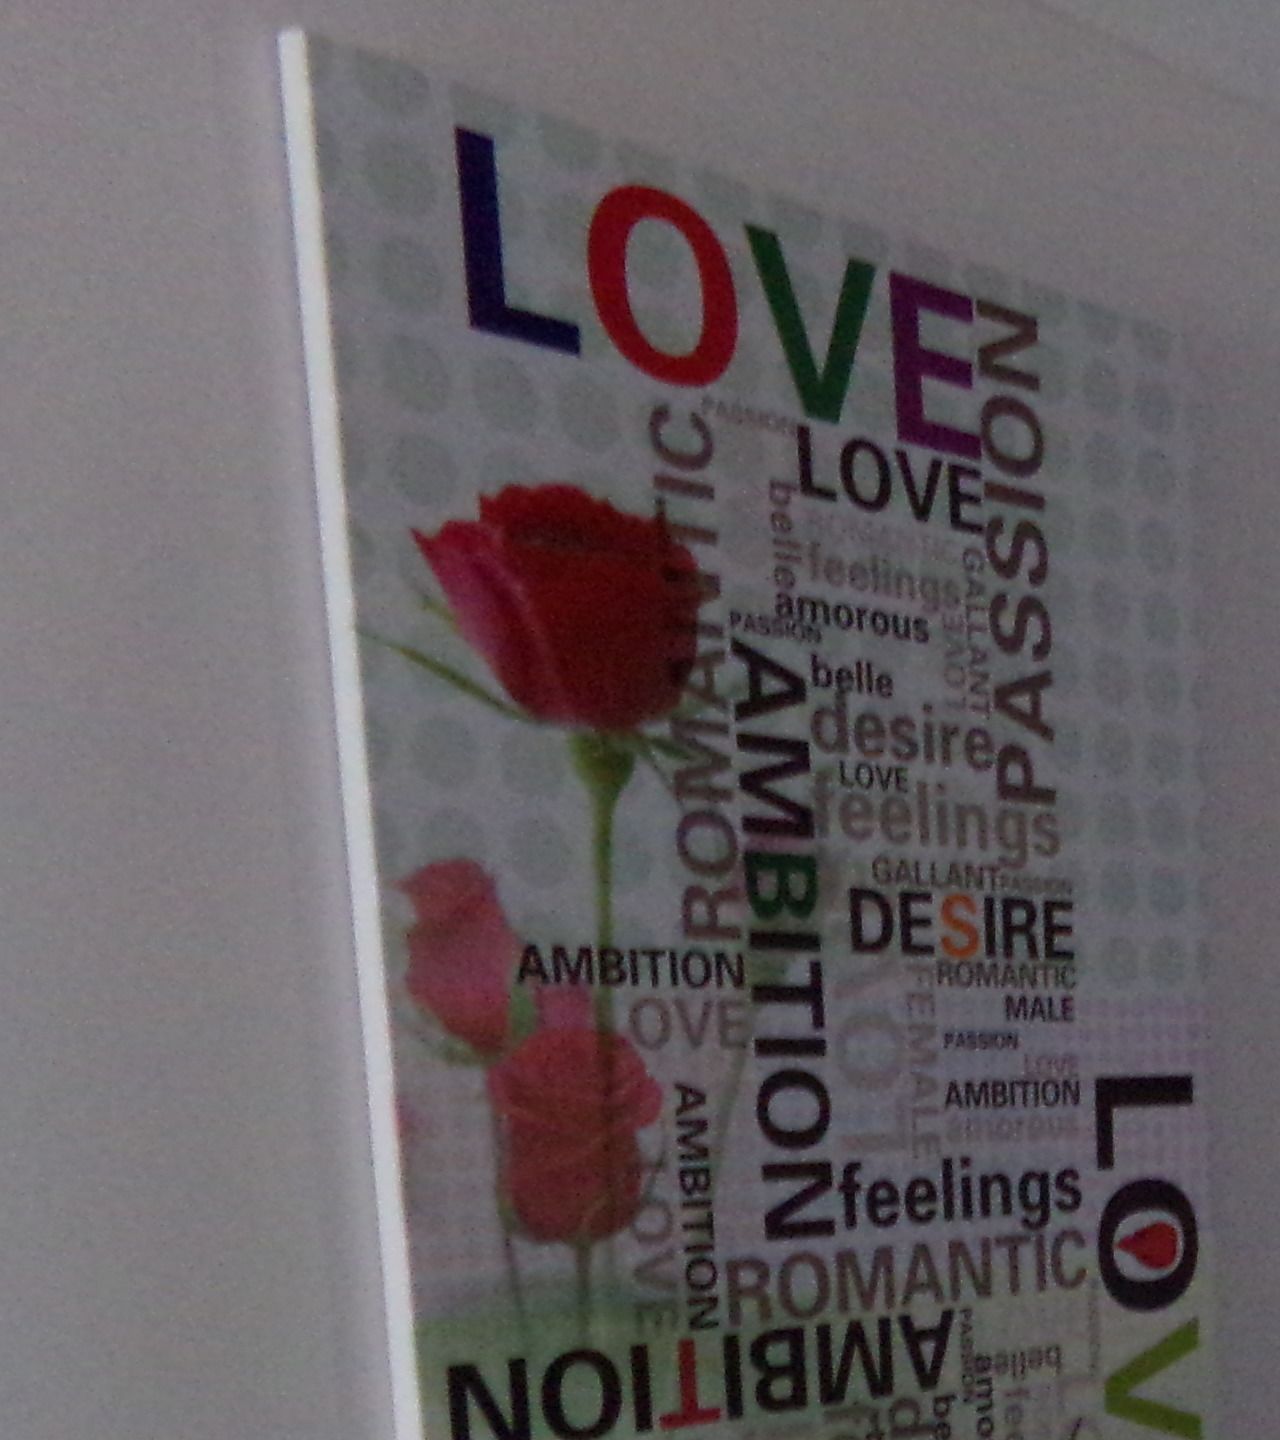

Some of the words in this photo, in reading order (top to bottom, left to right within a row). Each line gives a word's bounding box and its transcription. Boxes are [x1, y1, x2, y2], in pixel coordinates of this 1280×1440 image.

[453, 126, 983, 460] LOVE
[798, 424, 984, 537] LOVE
[808, 542, 960, 615] feelings
[975, 298, 1057, 805] PASSION
[774, 590, 931, 644] amorous
[961, 546, 992, 719] GALLANT
[649, 401, 742, 941] ROMANTIC
[810, 652, 894, 699] belle
[810, 692, 995, 773] desire
[839, 760, 909, 794] LOVE
[814, 766, 1062, 870] feelings
[872, 853, 999, 892] GALLANT
[731, 638, 837, 1242] AMBITION
[848, 886, 1076, 962] DESIRE
[516, 942, 746, 990] AMBITION
[936, 960, 1077, 991] ROMANTIC
[1003, 994, 1076, 1024] MALE
[943, 1077, 1082, 1111] AMBITION
[674, 1081, 720, 1332] AMBITION
[838, 1155, 1084, 1231] feelings
[725, 1230, 1087, 1326] ROMANTIC
